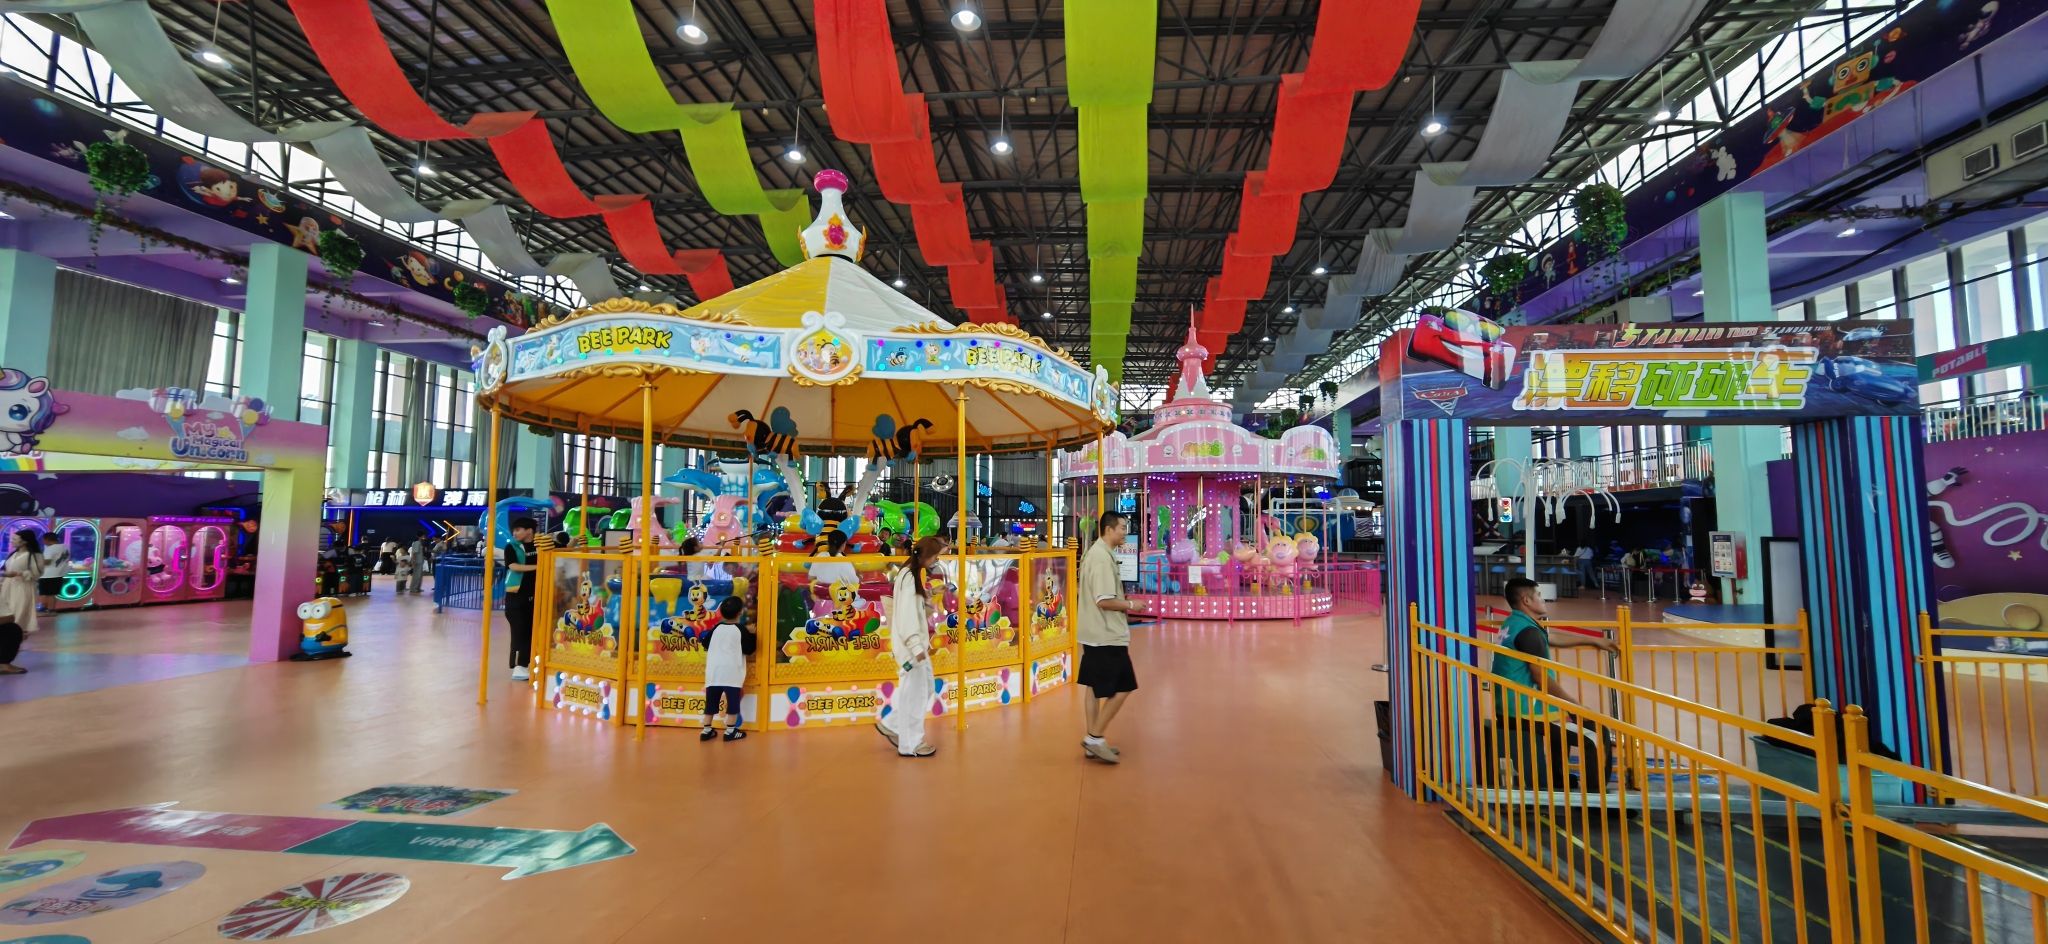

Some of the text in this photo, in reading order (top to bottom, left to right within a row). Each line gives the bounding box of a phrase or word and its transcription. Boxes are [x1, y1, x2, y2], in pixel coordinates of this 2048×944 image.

[577, 326, 673, 353] BEE PARK
[1613, 323, 1724, 347] STANDARD
[966, 346, 999, 365] BEE
[1932, 343, 1989, 378] POTABLE
[1523, 350, 1812, 409] 漂移碰碰车
[182, 422, 216, 438] My
[170, 437, 247, 461] Unicorn
[191, 436, 241, 449] Magical
[971, 682, 996, 697] PARK
[661, 697, 725, 711] BEE PAK
[807, 696, 874, 711] BEE PARK
